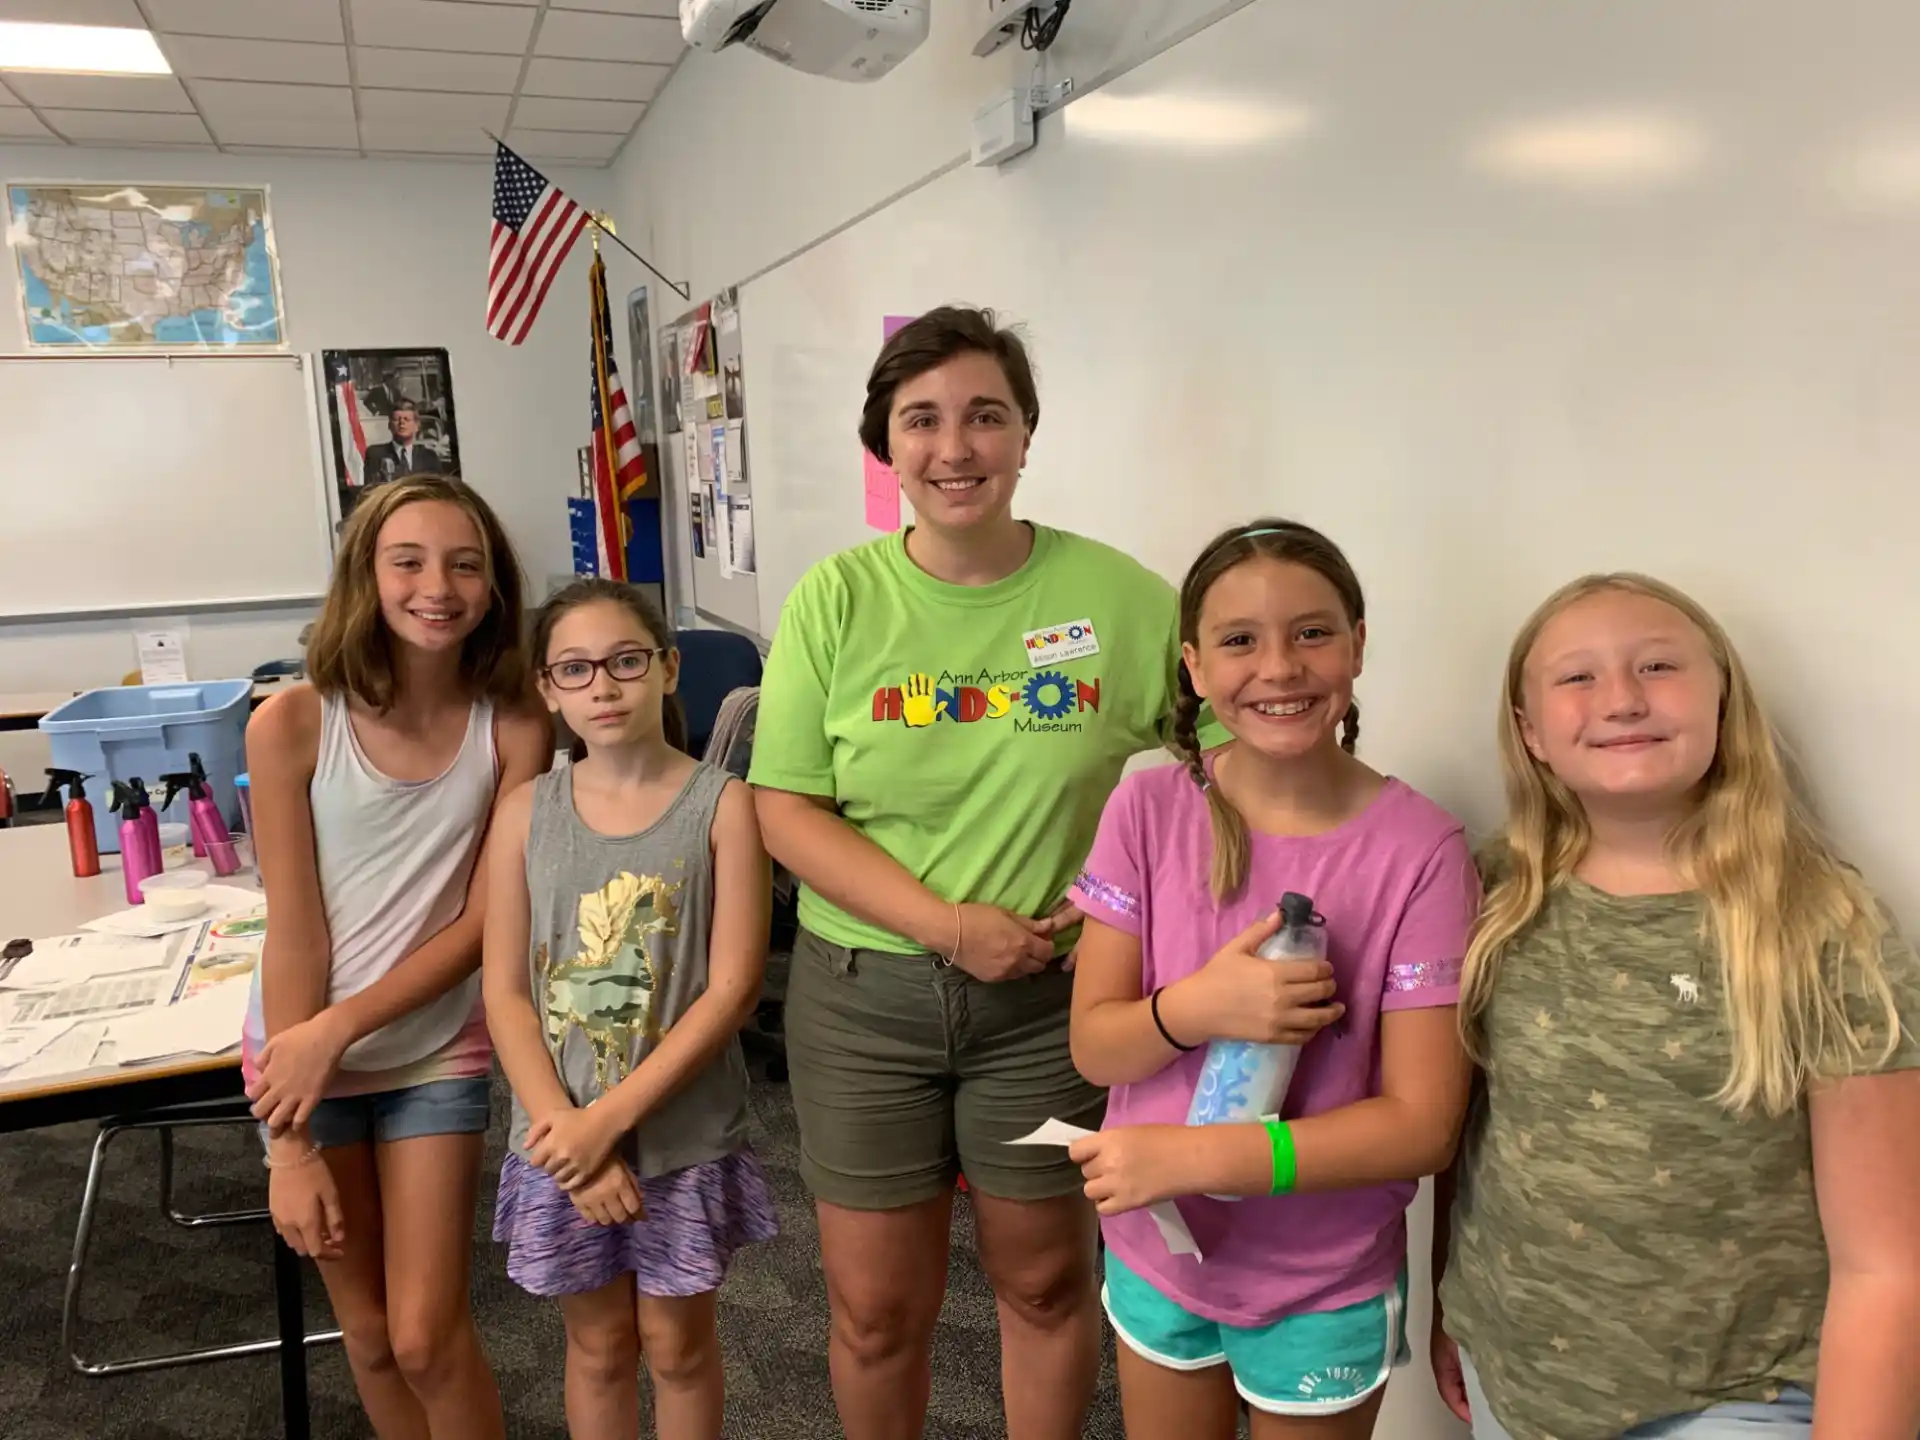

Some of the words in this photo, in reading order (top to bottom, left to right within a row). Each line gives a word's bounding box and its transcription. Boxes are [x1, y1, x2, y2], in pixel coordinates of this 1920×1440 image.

[937, 669, 973, 686] Ann
[976, 668, 1029, 685] Arbor
[1014, 718, 1082, 733] Museum
